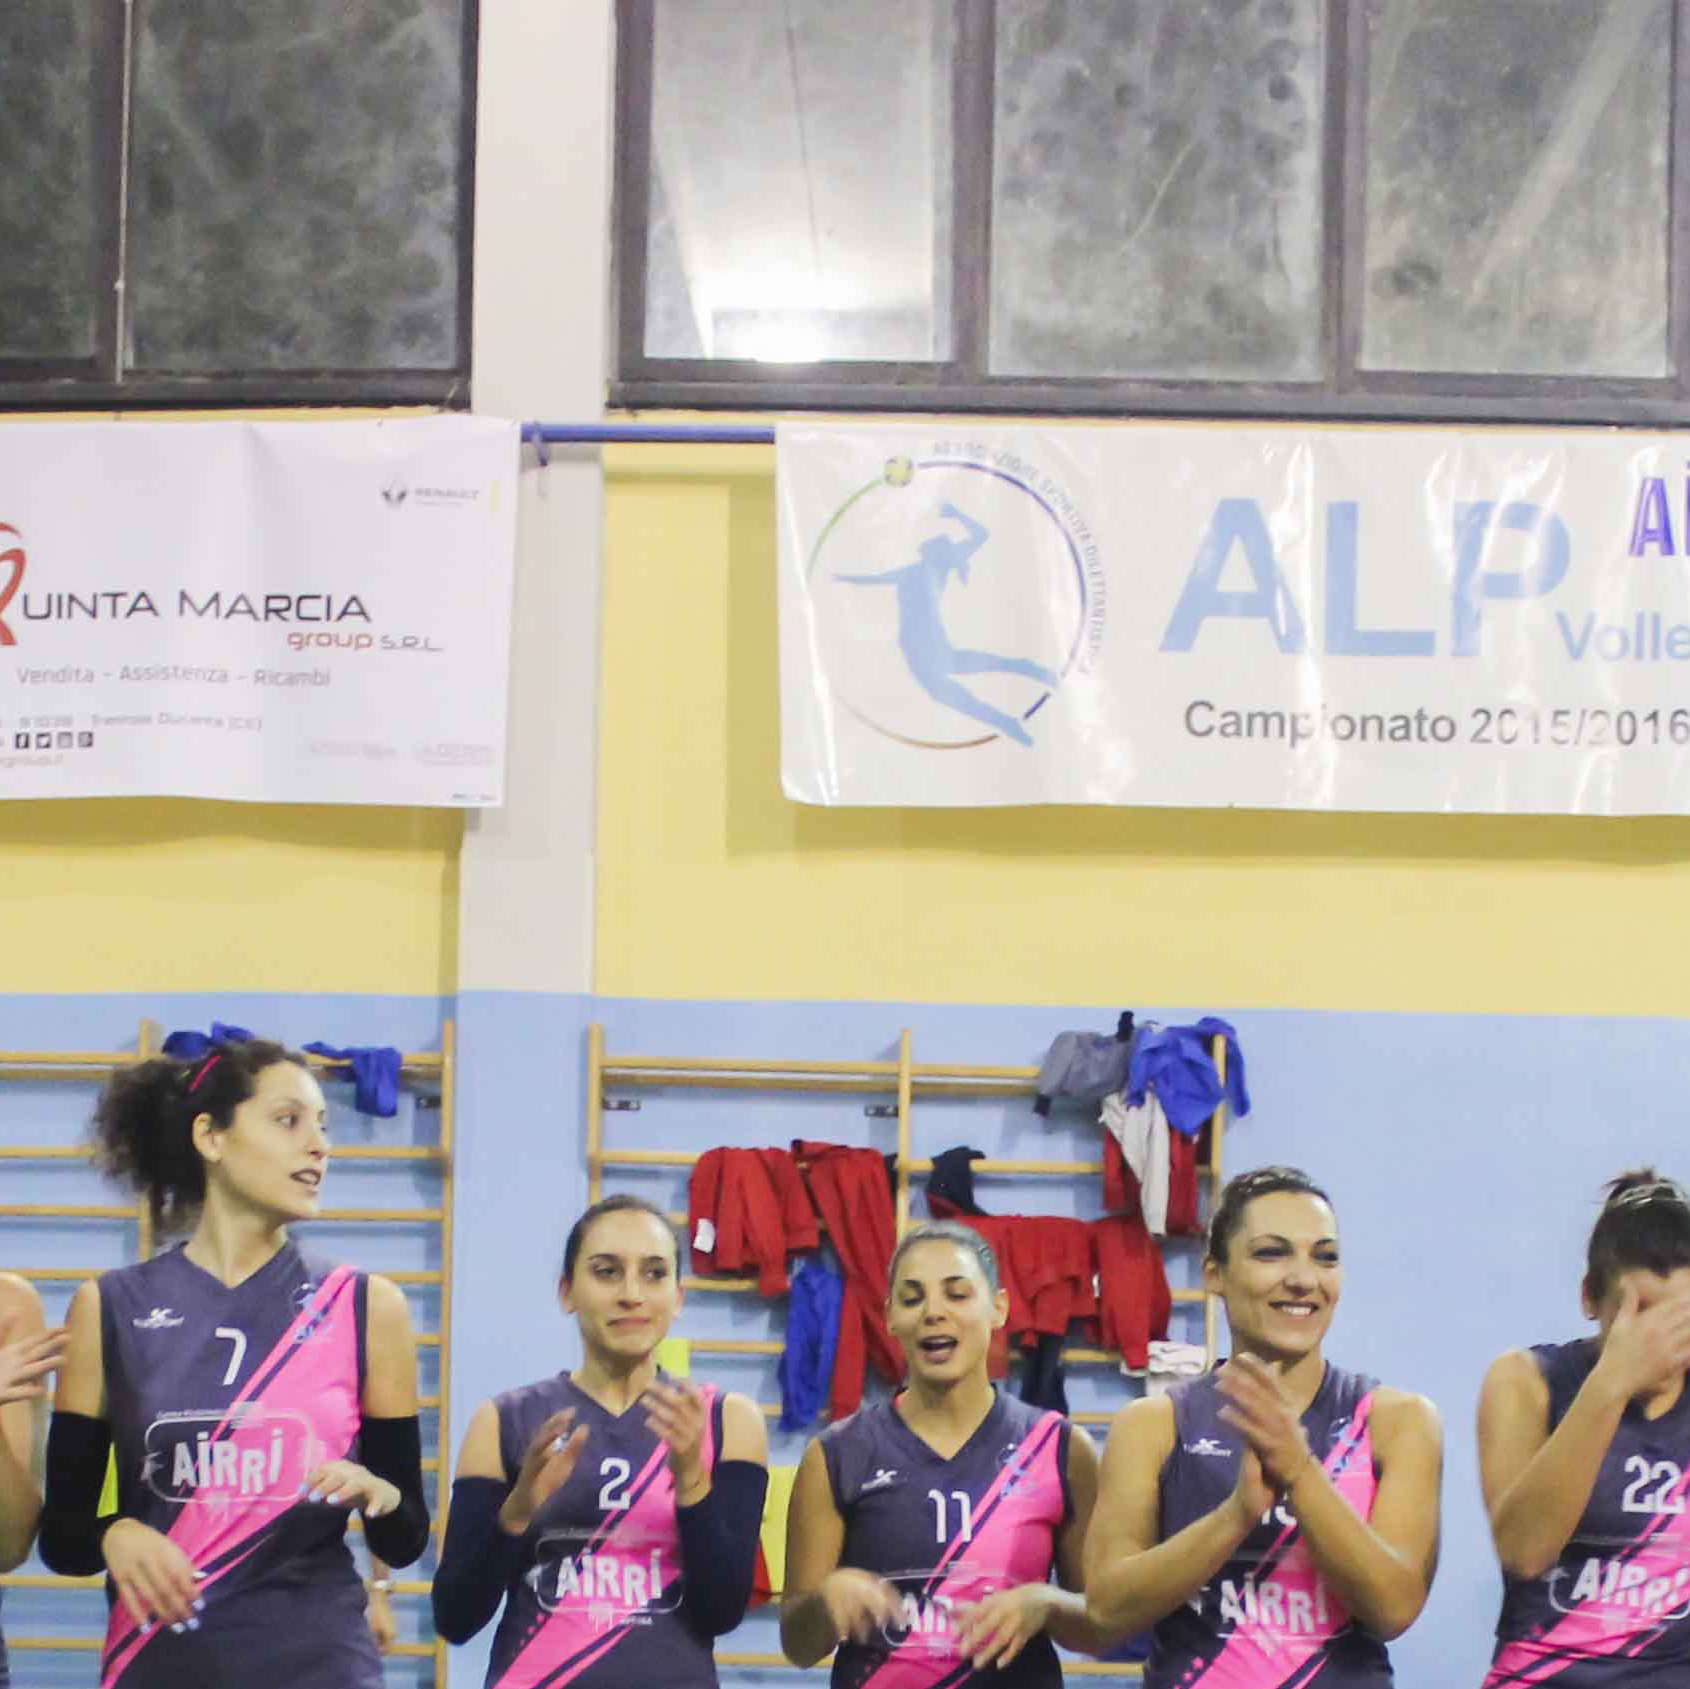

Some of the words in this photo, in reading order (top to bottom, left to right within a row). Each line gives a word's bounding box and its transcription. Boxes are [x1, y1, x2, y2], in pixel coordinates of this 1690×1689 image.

[1158, 496, 1571, 658] ALP
[178, 590, 372, 623] MARCIA
[287, 631, 373, 653] group
[17, 666, 95, 685] Vendita
[120, 664, 229, 684] Assistenza
[254, 669, 331, 687] Ricambi
[1184, 700, 1457, 749] Camponato
[214, 1327, 248, 1386] 7
[598, 1457, 632, 1511] 2
[1621, 1455, 1686, 1515] 22
[927, 1488, 973, 1544] 11
